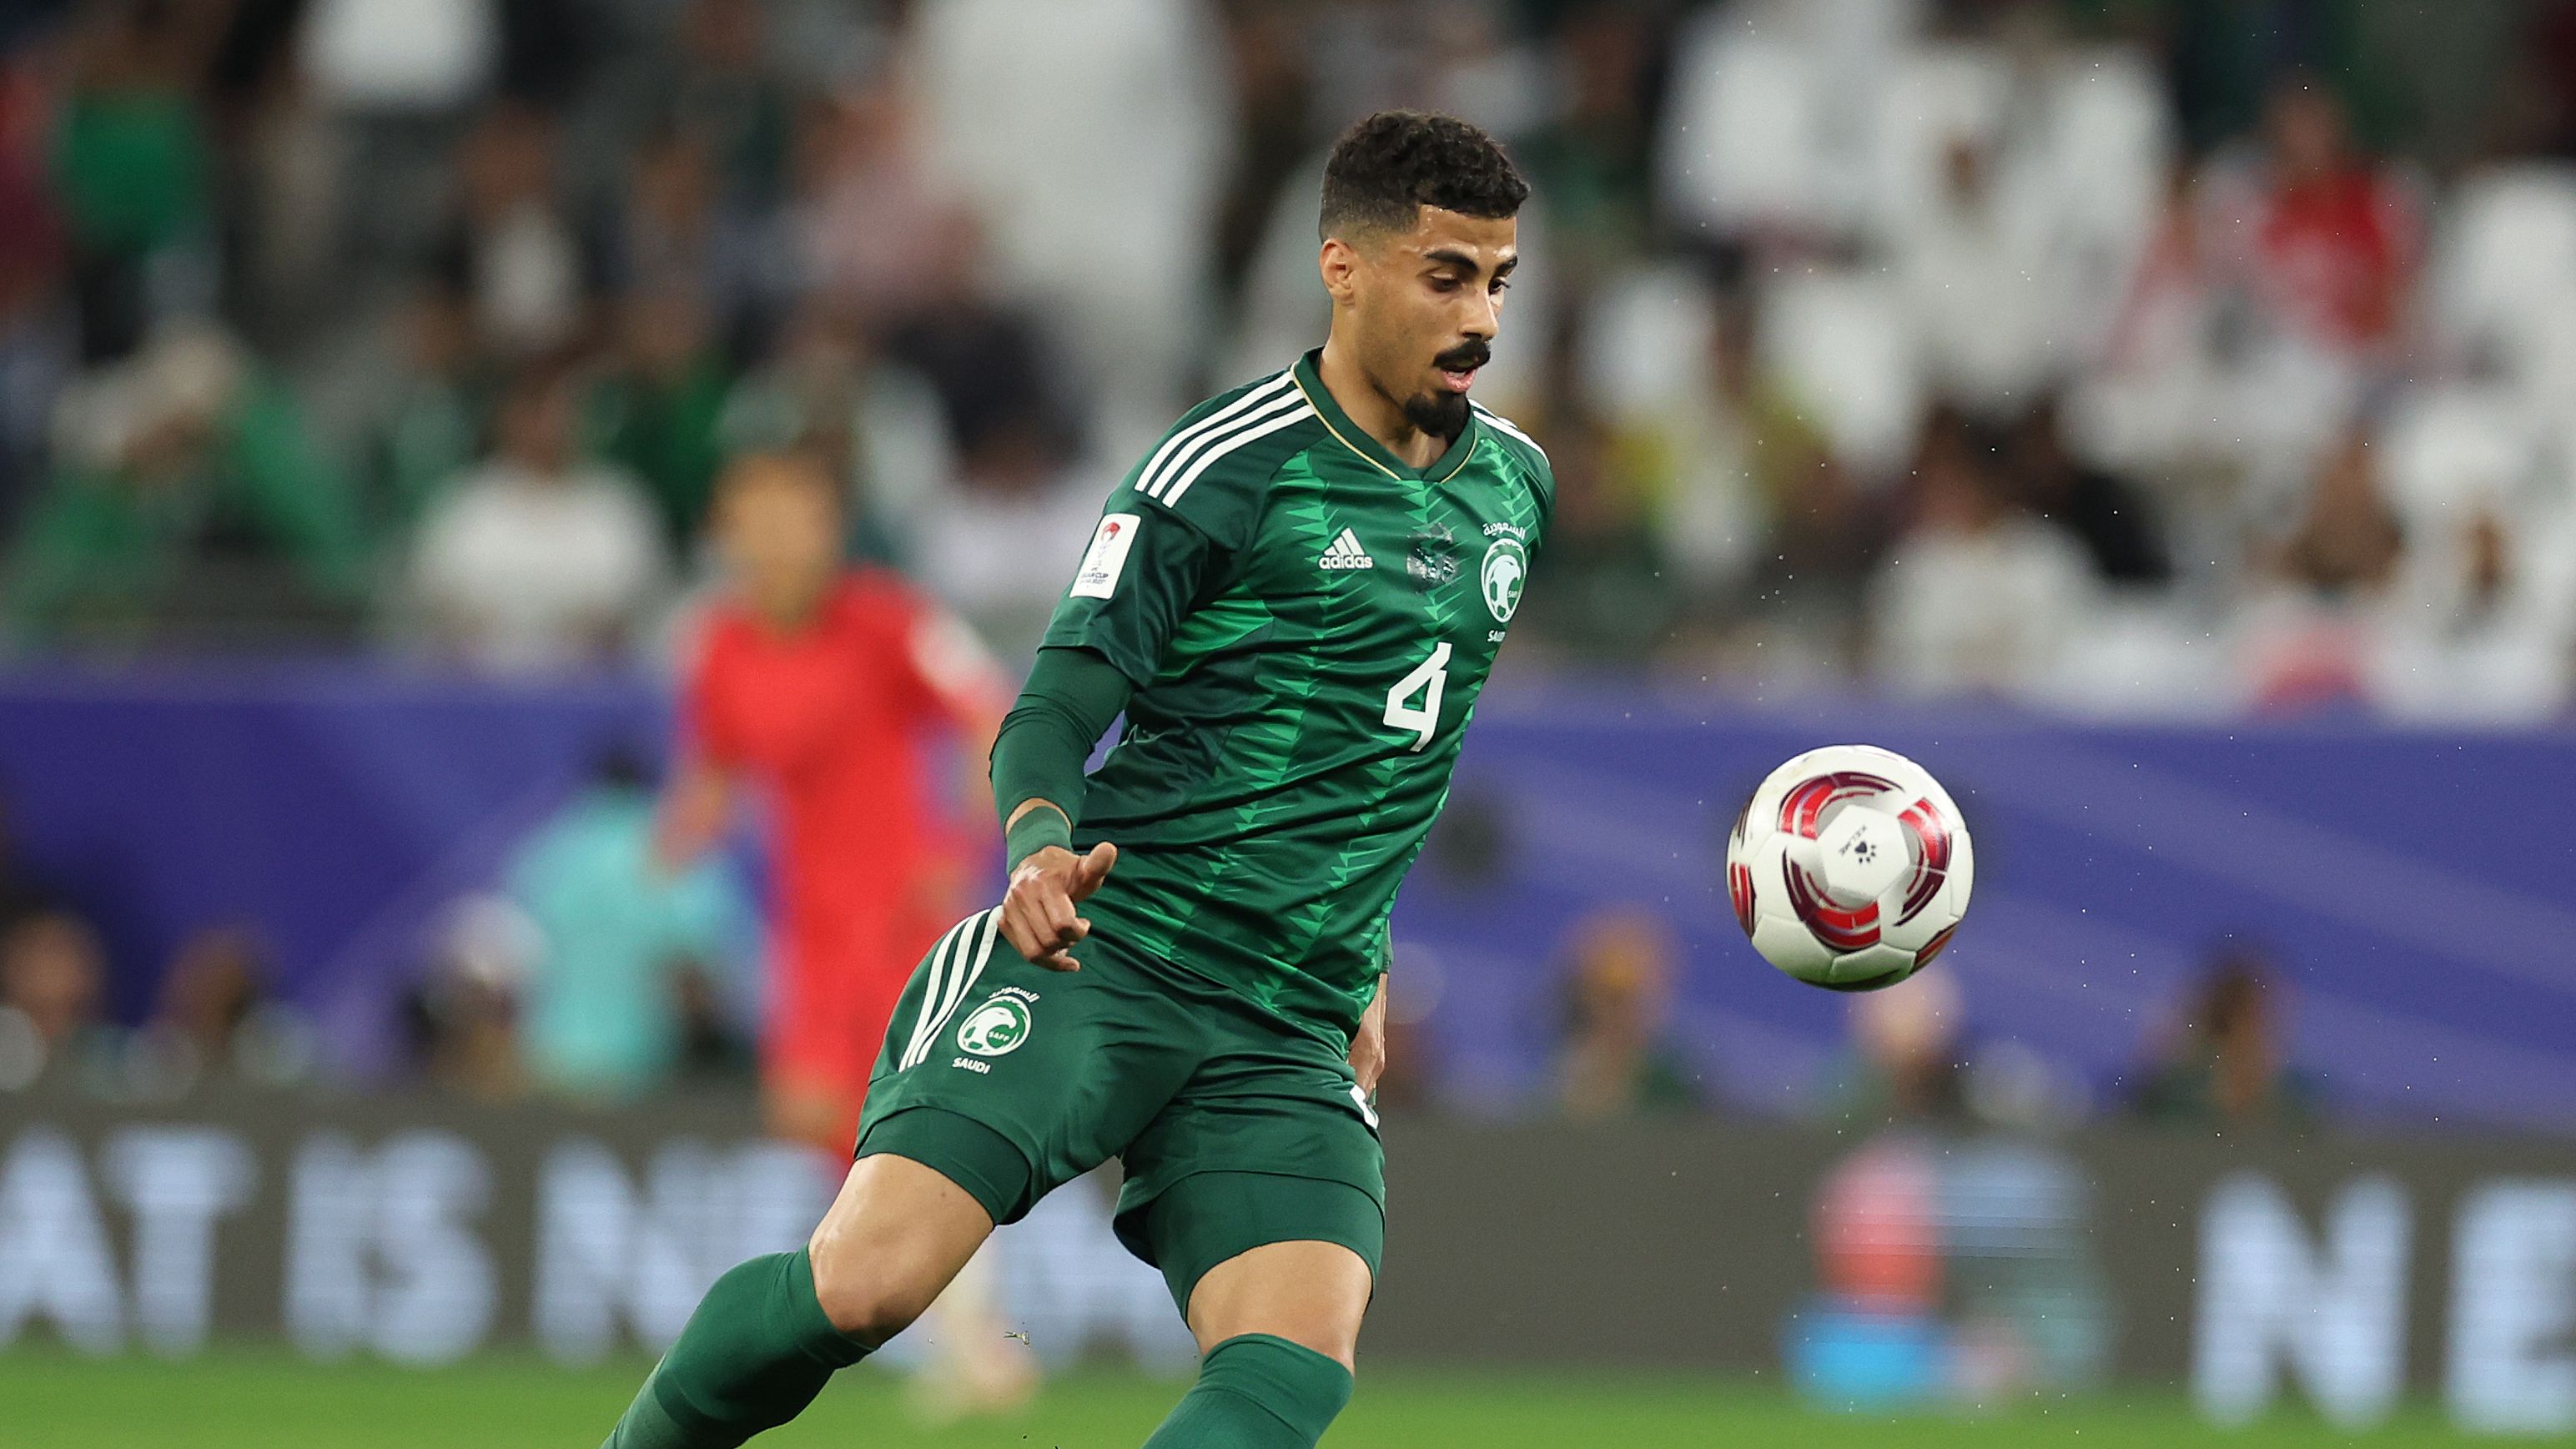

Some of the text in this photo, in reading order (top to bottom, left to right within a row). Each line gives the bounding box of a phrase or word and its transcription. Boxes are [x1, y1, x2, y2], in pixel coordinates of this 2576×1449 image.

[1482, 522, 1526, 541] السعودية
[1318, 555, 1374, 570] adidas
[1383, 641, 1452, 752] 4
[951, 1057, 991, 1074] SAUDI
[284, 1128, 496, 1368] IS
